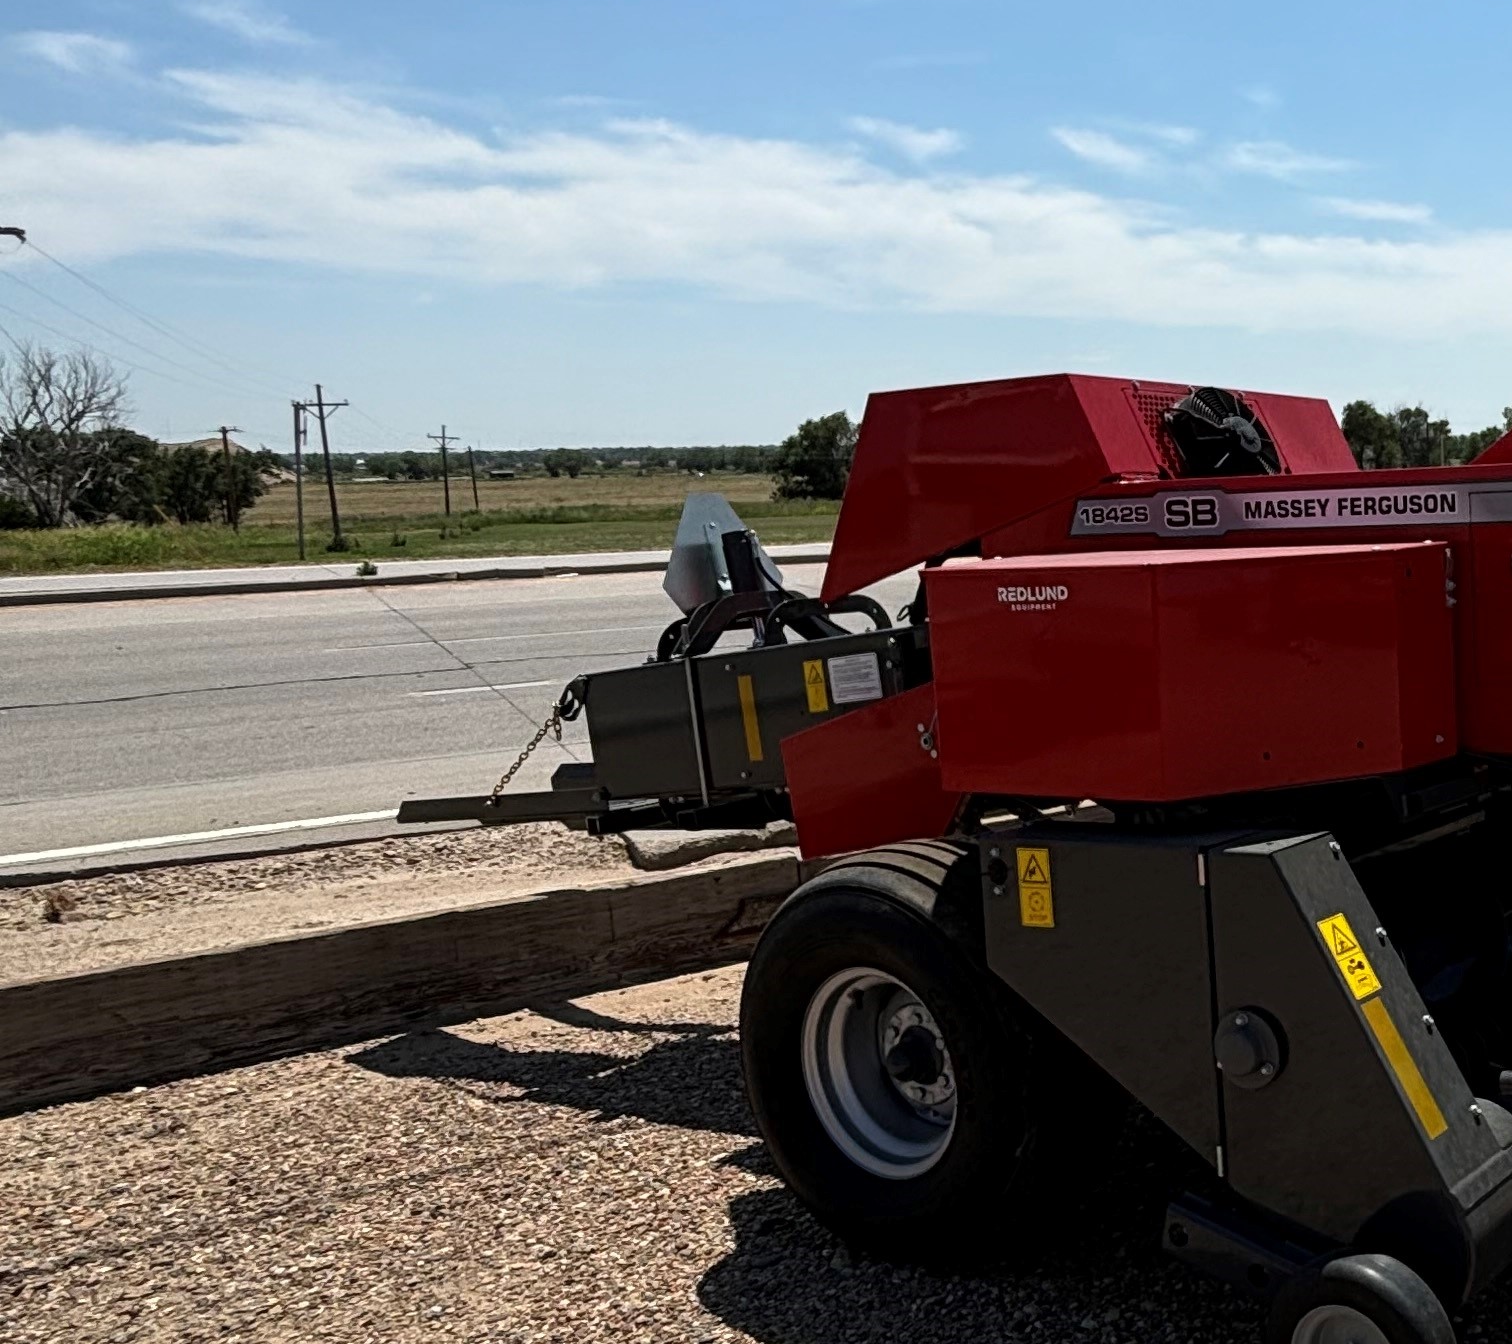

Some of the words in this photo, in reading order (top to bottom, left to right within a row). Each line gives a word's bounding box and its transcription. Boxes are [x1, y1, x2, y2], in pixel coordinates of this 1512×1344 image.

[1080, 505, 1150, 525] 1842S
[1165, 497, 1219, 529] SB
[1243, 498, 1330, 519] MASSEY
[1337, 493, 1457, 516] FERGUSON
[997, 586, 1069, 602] REDLUND
